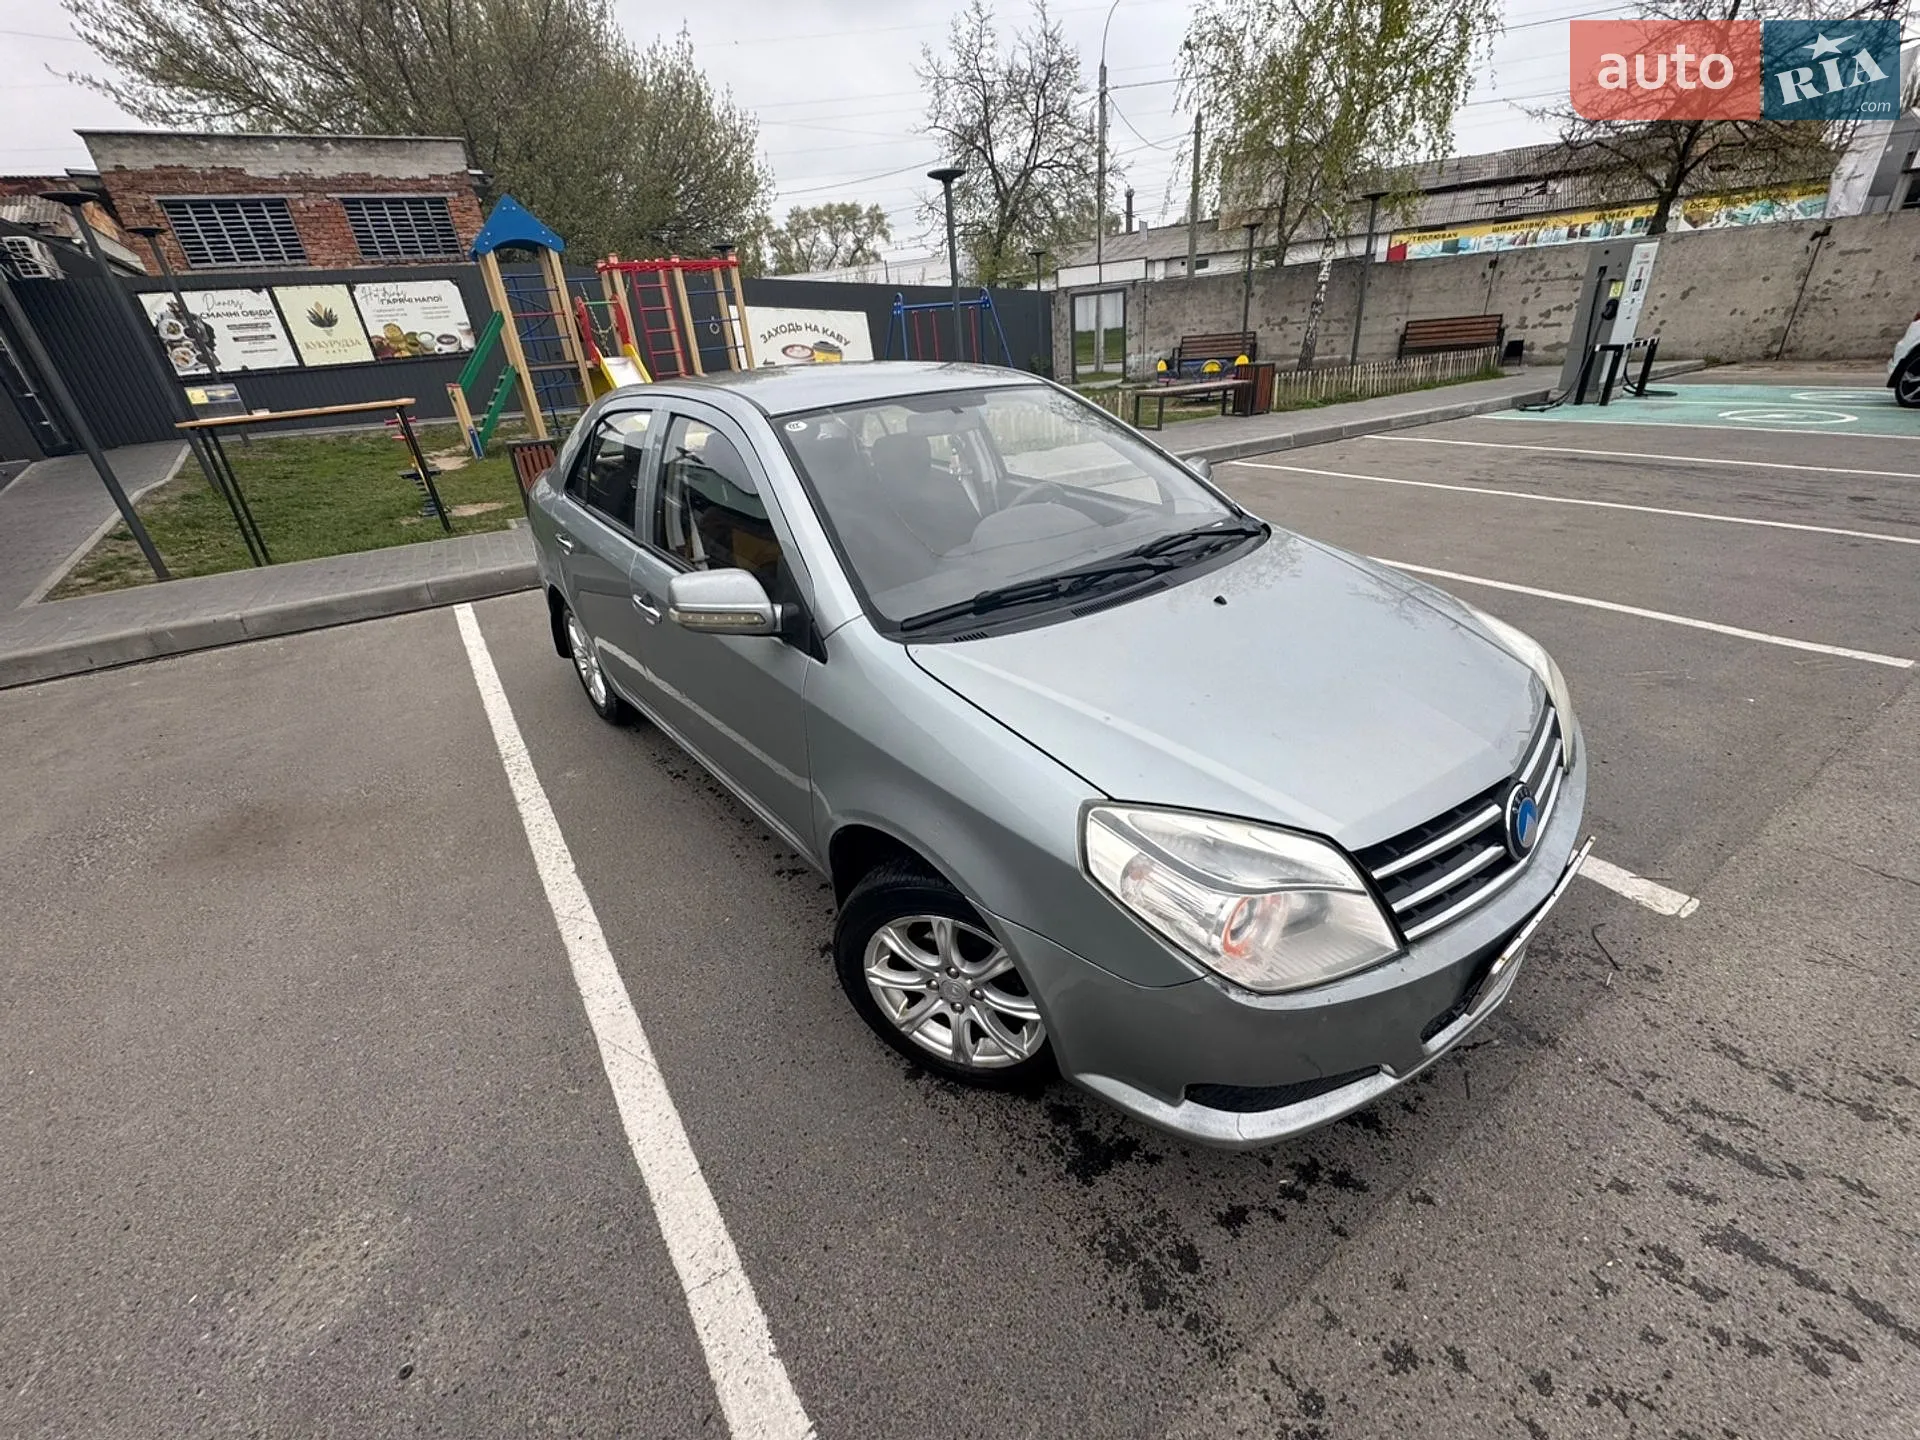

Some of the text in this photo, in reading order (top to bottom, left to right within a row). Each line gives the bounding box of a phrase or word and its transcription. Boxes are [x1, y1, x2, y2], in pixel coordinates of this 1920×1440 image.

[200, 310, 240, 319] СМАЧНІ
[760, 322, 851, 347] ЗАХОДЬ НА КАВУ
